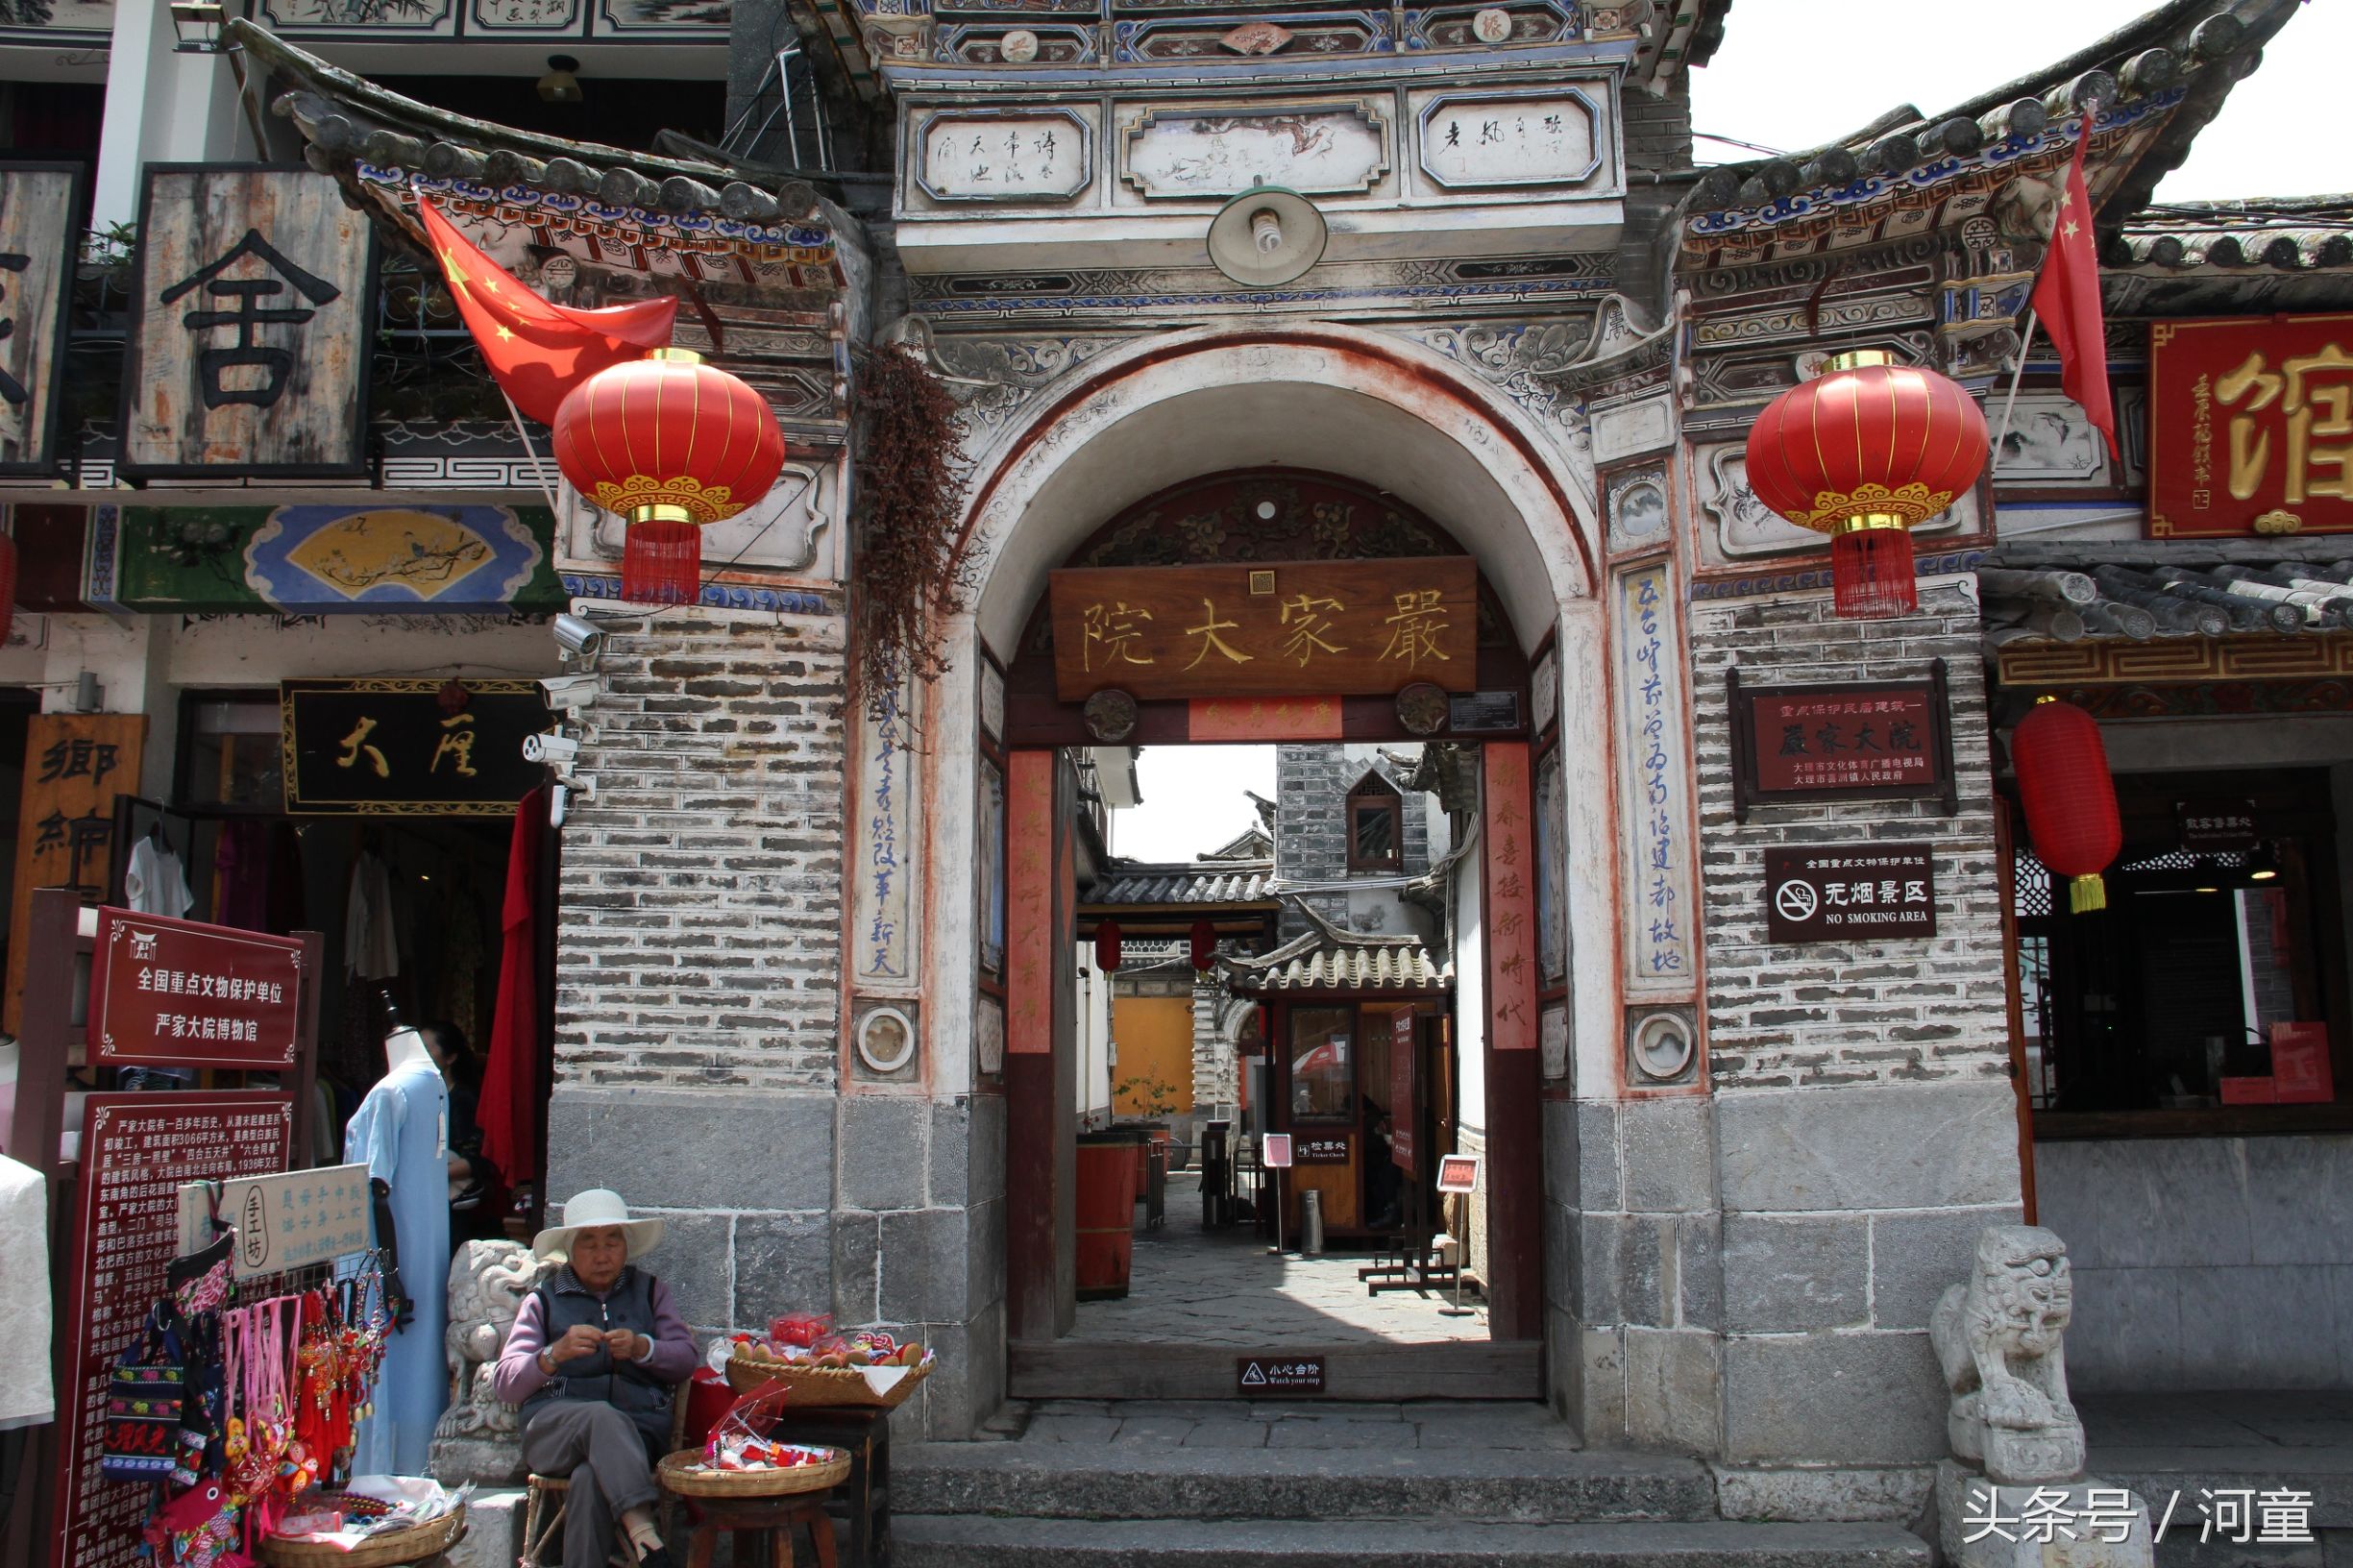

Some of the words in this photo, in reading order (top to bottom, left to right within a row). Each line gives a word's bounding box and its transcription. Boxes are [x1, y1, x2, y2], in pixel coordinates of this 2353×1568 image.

[161, 229, 340, 410] 舍
[2214, 342, 2353, 504] 馆
[1793, 756, 1924, 772] 大理市文化体育广播电视局
[1794, 771, 1903, 784] 大理市喜洲镇人民政府
[1805, 856, 1925, 870] 全国重点文物保护单位
[1826, 880, 1928, 907] 无烟景区
[1826, 914, 1842, 924] NO
[1848, 912, 1897, 923] SMOKING
[1899, 911, 1927, 922] AREA
[137, 967, 282, 1004] 全国重点文物保护单位
[155, 1013, 258, 1041] 严家大院博物馆
[247, 1195, 263, 1260] 手工坊
[1269, 1363, 1320, 1375] 小心台阶
[1307, 1377, 1320, 1385] step
